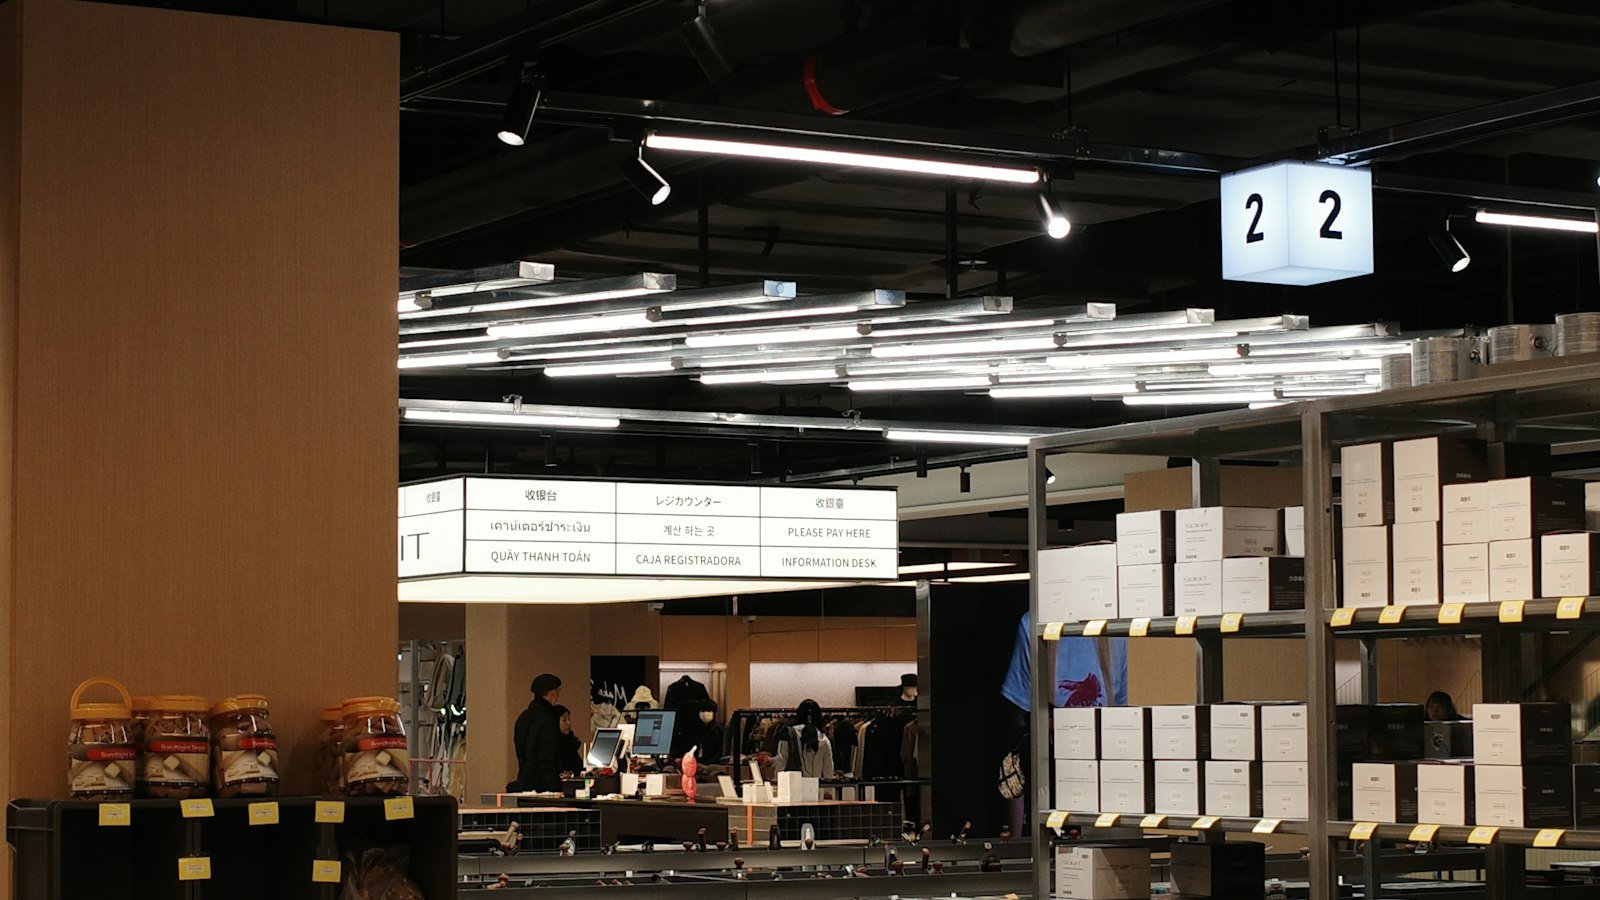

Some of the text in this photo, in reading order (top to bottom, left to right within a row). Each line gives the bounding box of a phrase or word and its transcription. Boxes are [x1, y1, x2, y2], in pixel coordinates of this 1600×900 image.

[1245, 193, 1264, 244] 2
[1318, 189, 1343, 240] 2
[525, 489, 557, 502] 收银台
[656, 496, 722, 508] レジカウンター
[816, 498, 843, 508] 收銀臺
[663, 525, 715, 537] 계산 하는 곳
[788, 528, 870, 538] PLEASE PAY HERE
[523, 552, 559, 561] THANH
[563, 551, 590, 562] TOÁN
[636, 555, 741, 565] CAJA REGISTRADORA
[783, 558, 876, 567] INFORMATION DESK
